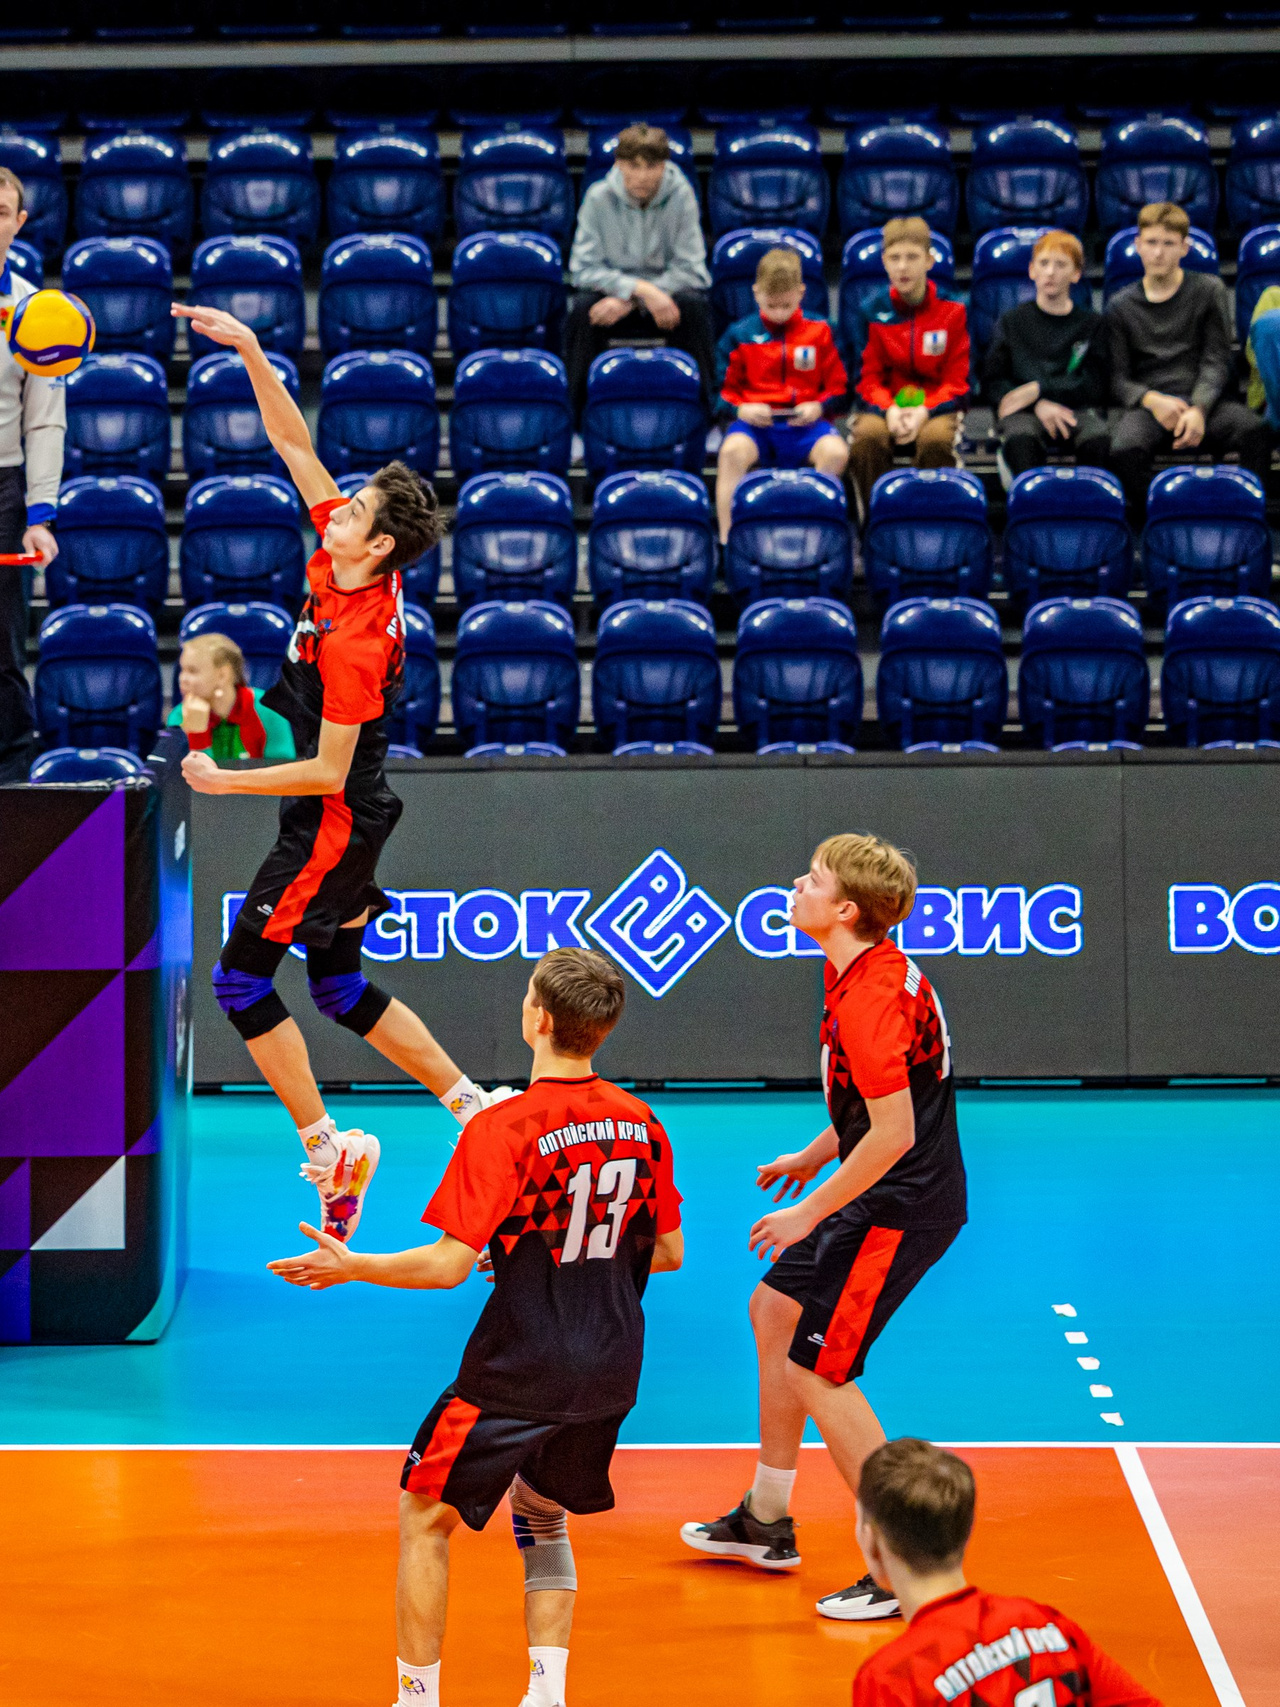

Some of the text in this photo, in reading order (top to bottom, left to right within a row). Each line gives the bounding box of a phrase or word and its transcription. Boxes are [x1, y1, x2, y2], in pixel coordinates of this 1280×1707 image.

[221, 883, 1084, 963] СТОК СВИС
[617, 1120, 649, 1144] КРАЙ
[560, 1158, 637, 1264] 13
